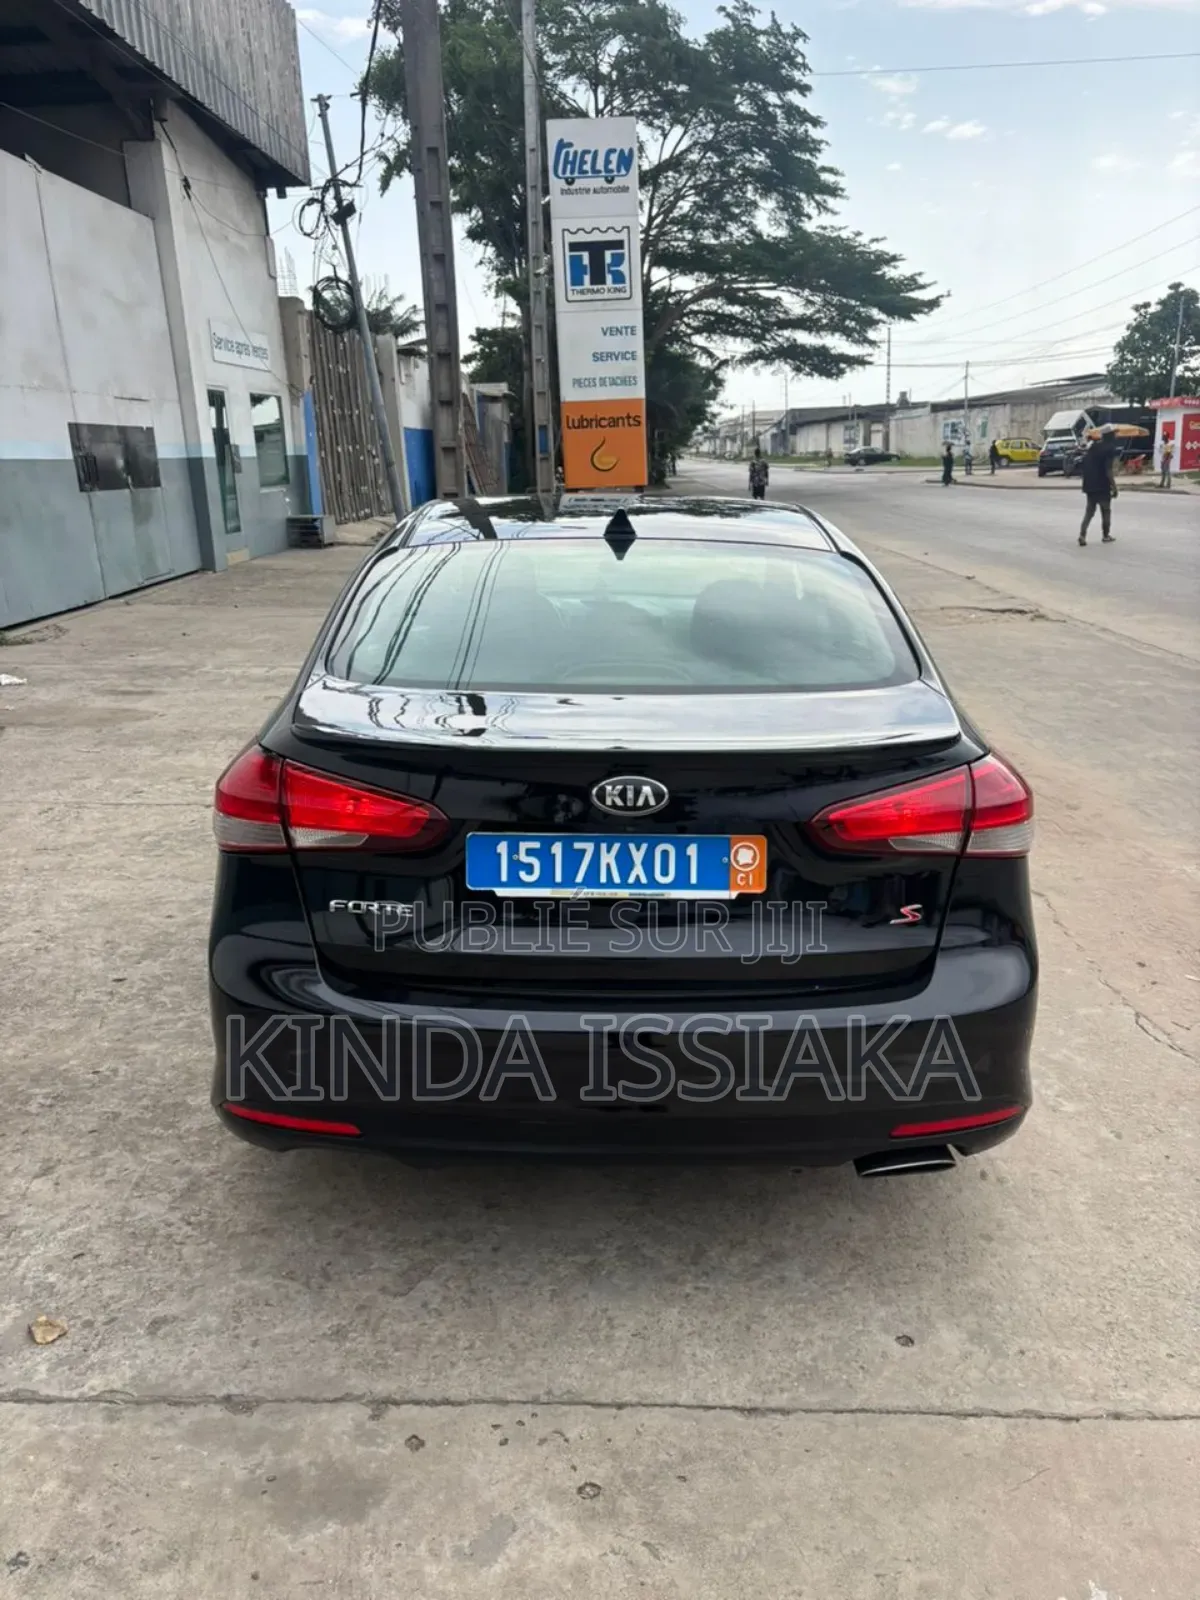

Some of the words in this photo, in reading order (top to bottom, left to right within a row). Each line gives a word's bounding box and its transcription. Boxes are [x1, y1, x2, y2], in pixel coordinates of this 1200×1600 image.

[571, 287, 606, 296] THERMO
[607, 286, 627, 294] KING
[601, 325, 637, 336] VENTE
[592, 351, 638, 362] SERVICE
[572, 377, 597, 389] PIECES
[604, 784, 657, 807] KIA
[496, 840, 699, 885] 1517KX01
[329, 900, 413, 917] FORTE
